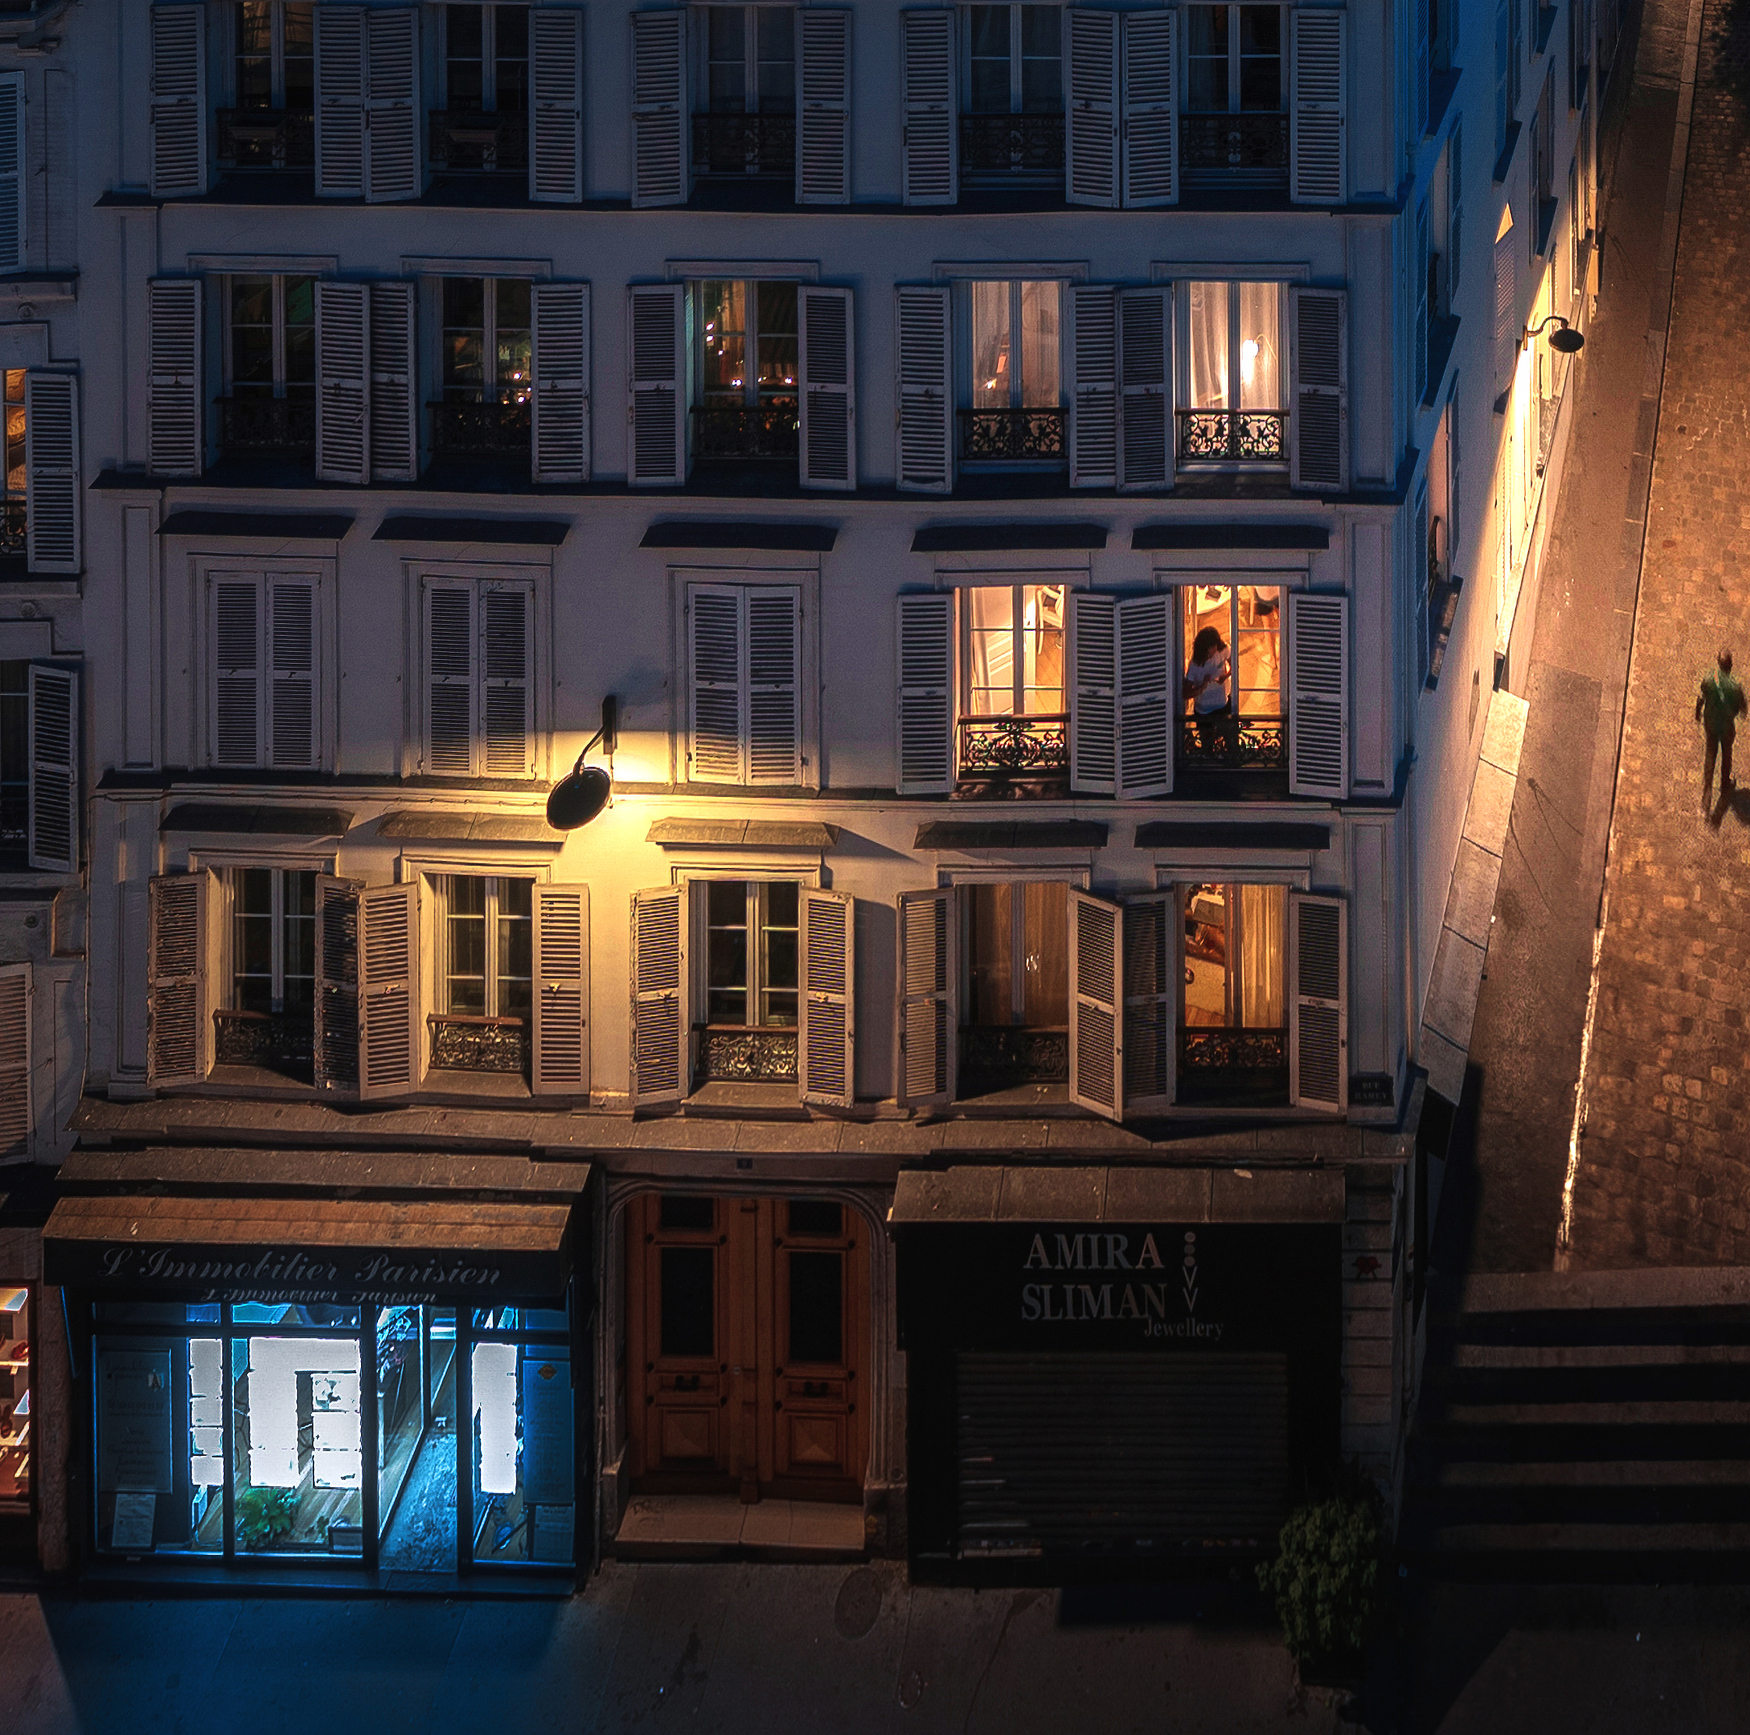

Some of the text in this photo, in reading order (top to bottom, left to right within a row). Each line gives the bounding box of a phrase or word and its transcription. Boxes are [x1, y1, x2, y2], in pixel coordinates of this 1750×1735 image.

[98, 1247, 500, 1286] L'Immobilier Parisien
[1023, 1232, 1166, 1270] AMIRA
[1021, 1282, 1168, 1321] SLIMAN
[1144, 1316, 1224, 1341] Jewellery
